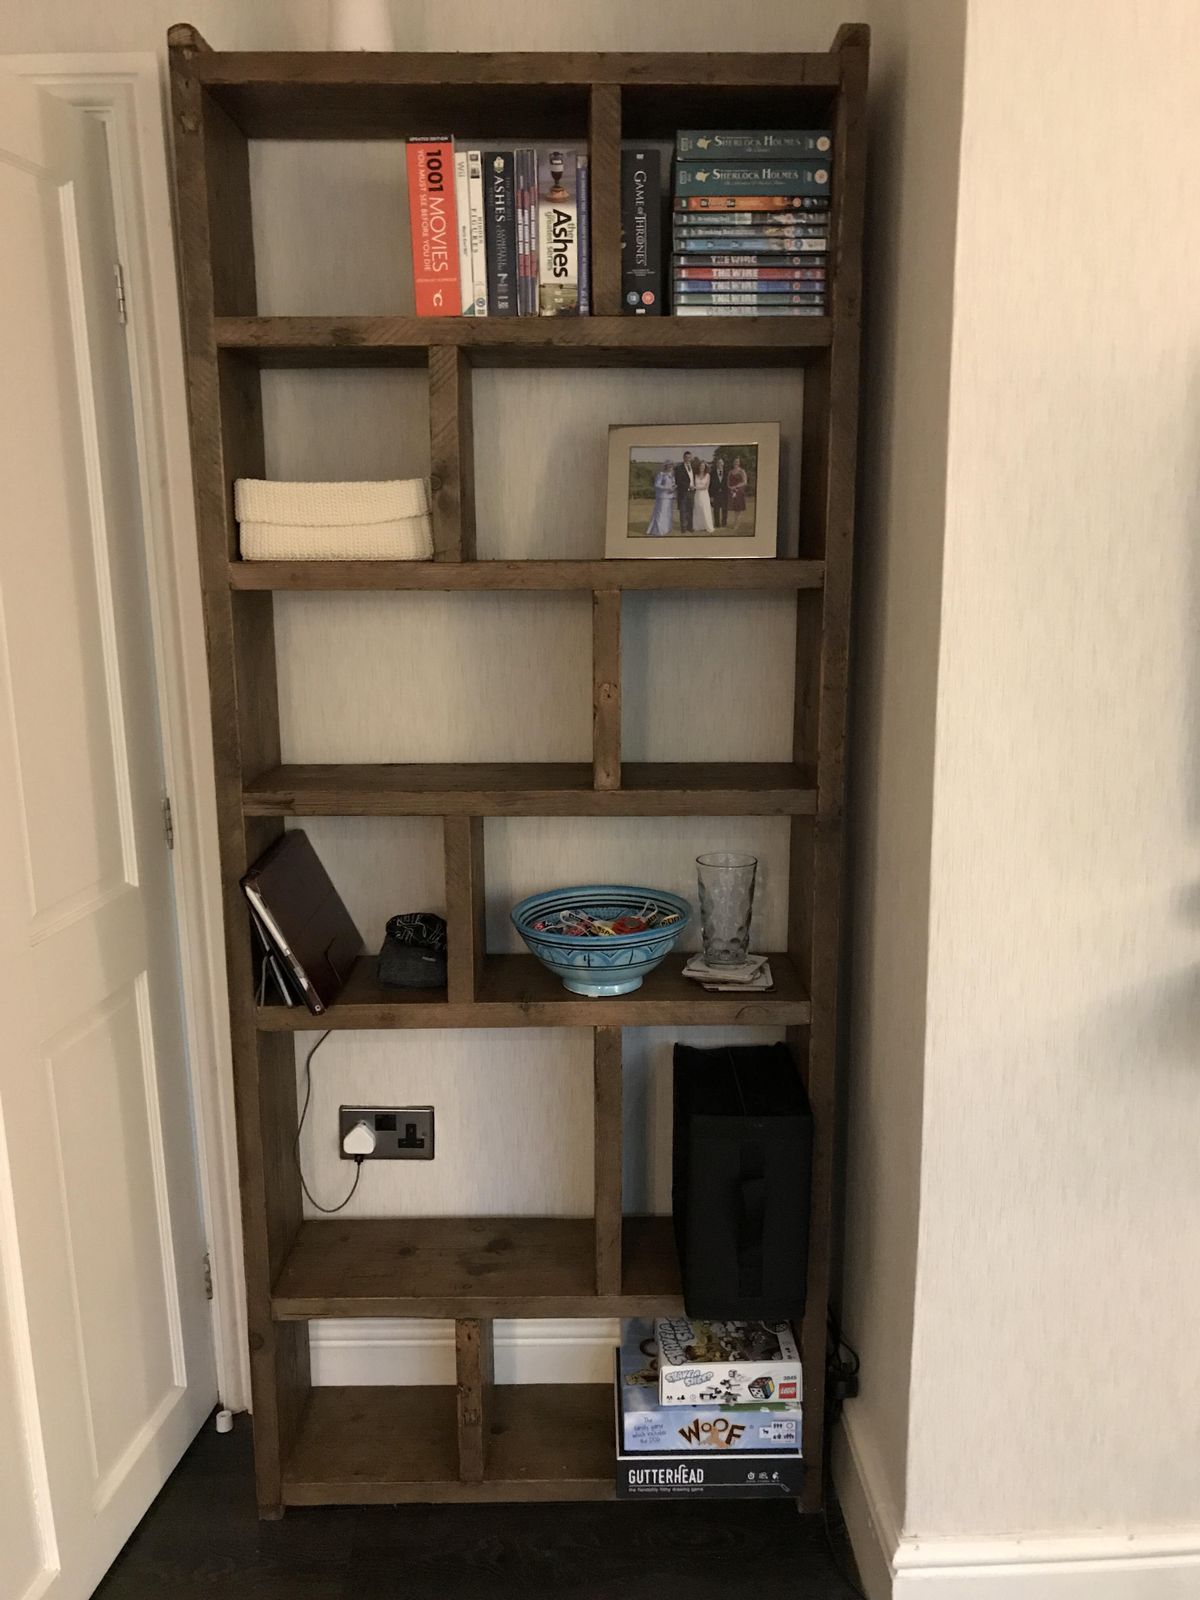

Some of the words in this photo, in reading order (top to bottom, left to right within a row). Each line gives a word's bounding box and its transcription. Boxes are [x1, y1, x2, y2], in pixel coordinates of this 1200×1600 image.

[714, 136, 762, 146] SHERLOCK
[764, 136, 801, 146] HOLMES
[417, 149, 426, 168] YOU
[426, 149, 444, 192] 1001
[457, 161, 466, 178] Wii
[712, 169, 760, 180] SHERLOCK
[762, 168, 799, 179] HOLMES
[418, 169, 426, 192] MUST
[633, 170, 647, 206] GAME
[420, 194, 428, 206] SEE
[494, 175, 506, 222] ASHES
[421, 208, 430, 237] BEFORE
[544, 211, 554, 244] greatest
[568, 223, 576, 239] the
[429, 197, 448, 273] MOVIES
[553, 208, 573, 278] Ashes
[634, 213, 647, 266] THRONES
[422, 240, 430, 258] YOU
[546, 246, 555, 271] series
[424, 259, 432, 271] DIE
[712, 269, 730, 278] THE
[731, 269, 758, 278] WIRE
[711, 282, 730, 290] THE
[731, 282, 757, 290] WIRE
[711, 294, 730, 303] THE
[731, 294, 757, 303] WIRE
[780, 1386, 796, 1395] LEGO
[678, 1418, 746, 1445] WOOF
[628, 1464, 704, 1484] GUTTERHEAD
